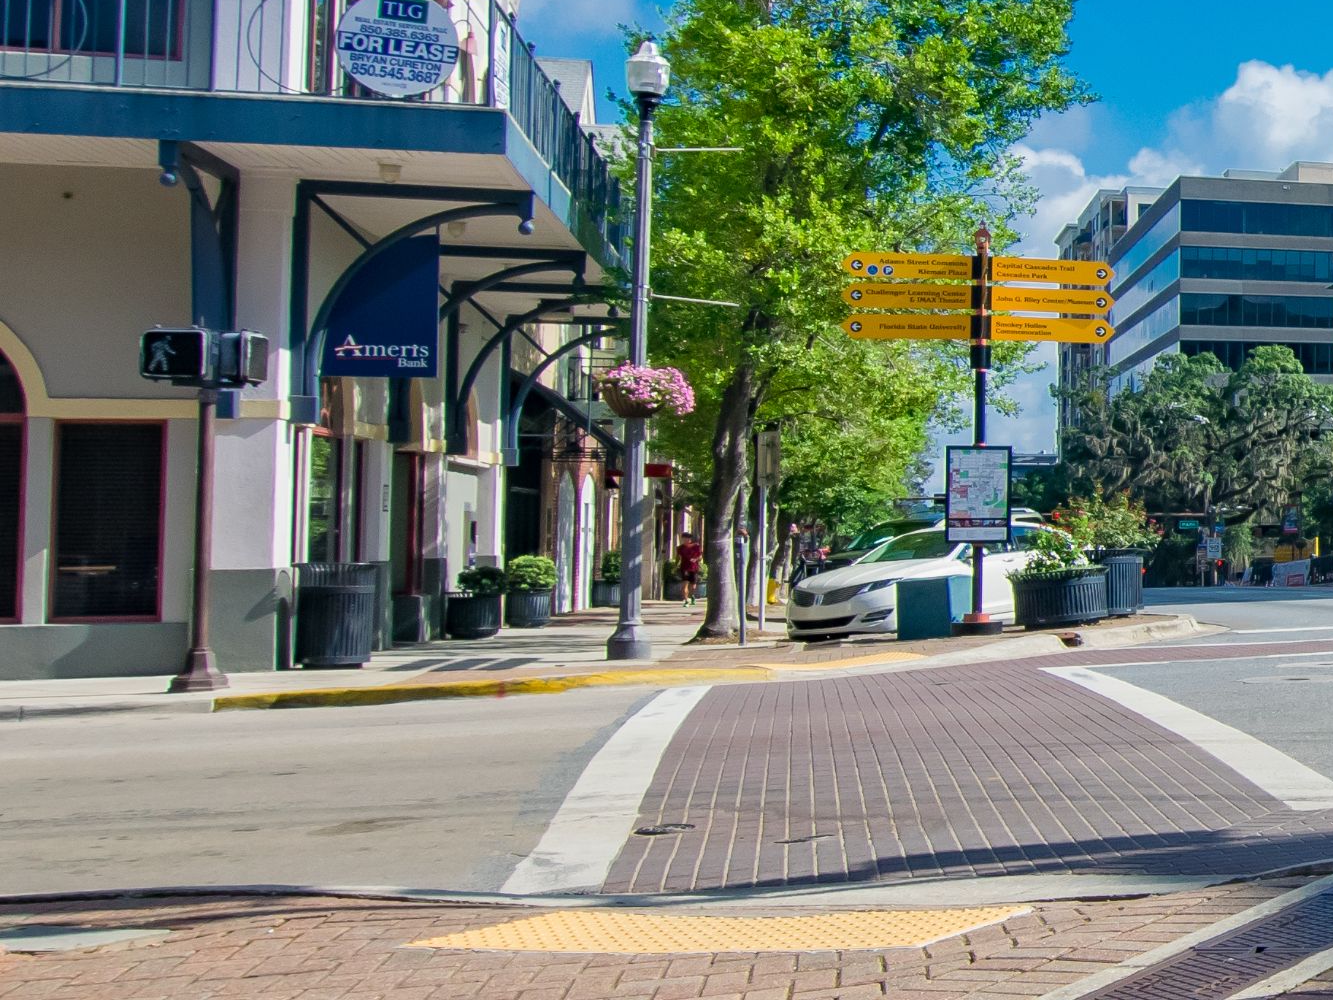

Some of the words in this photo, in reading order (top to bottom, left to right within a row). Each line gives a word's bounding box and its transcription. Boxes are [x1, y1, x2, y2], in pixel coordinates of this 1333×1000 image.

[384, 0, 423, 19] TLG
[354, 16, 371, 24] REAL
[373, 18, 397, 28] ESTATE
[360, 24, 440, 42] 850.385.6363
[339, 34, 383, 53] FOR
[388, 39, 457, 63] LEASE
[350, 53, 388, 65] BRYAN
[389, 56, 442, 72] CURETON
[351, 63, 441, 84] 850.545.3687
[996, 262, 1023, 270] Capital
[1024, 263, 1057, 271] Cascades
[865, 289, 906, 297] Challenger
[907, 289, 940, 297] Learning
[334, 334, 429, 357] Ameris
[397, 358, 428, 368] Bank
